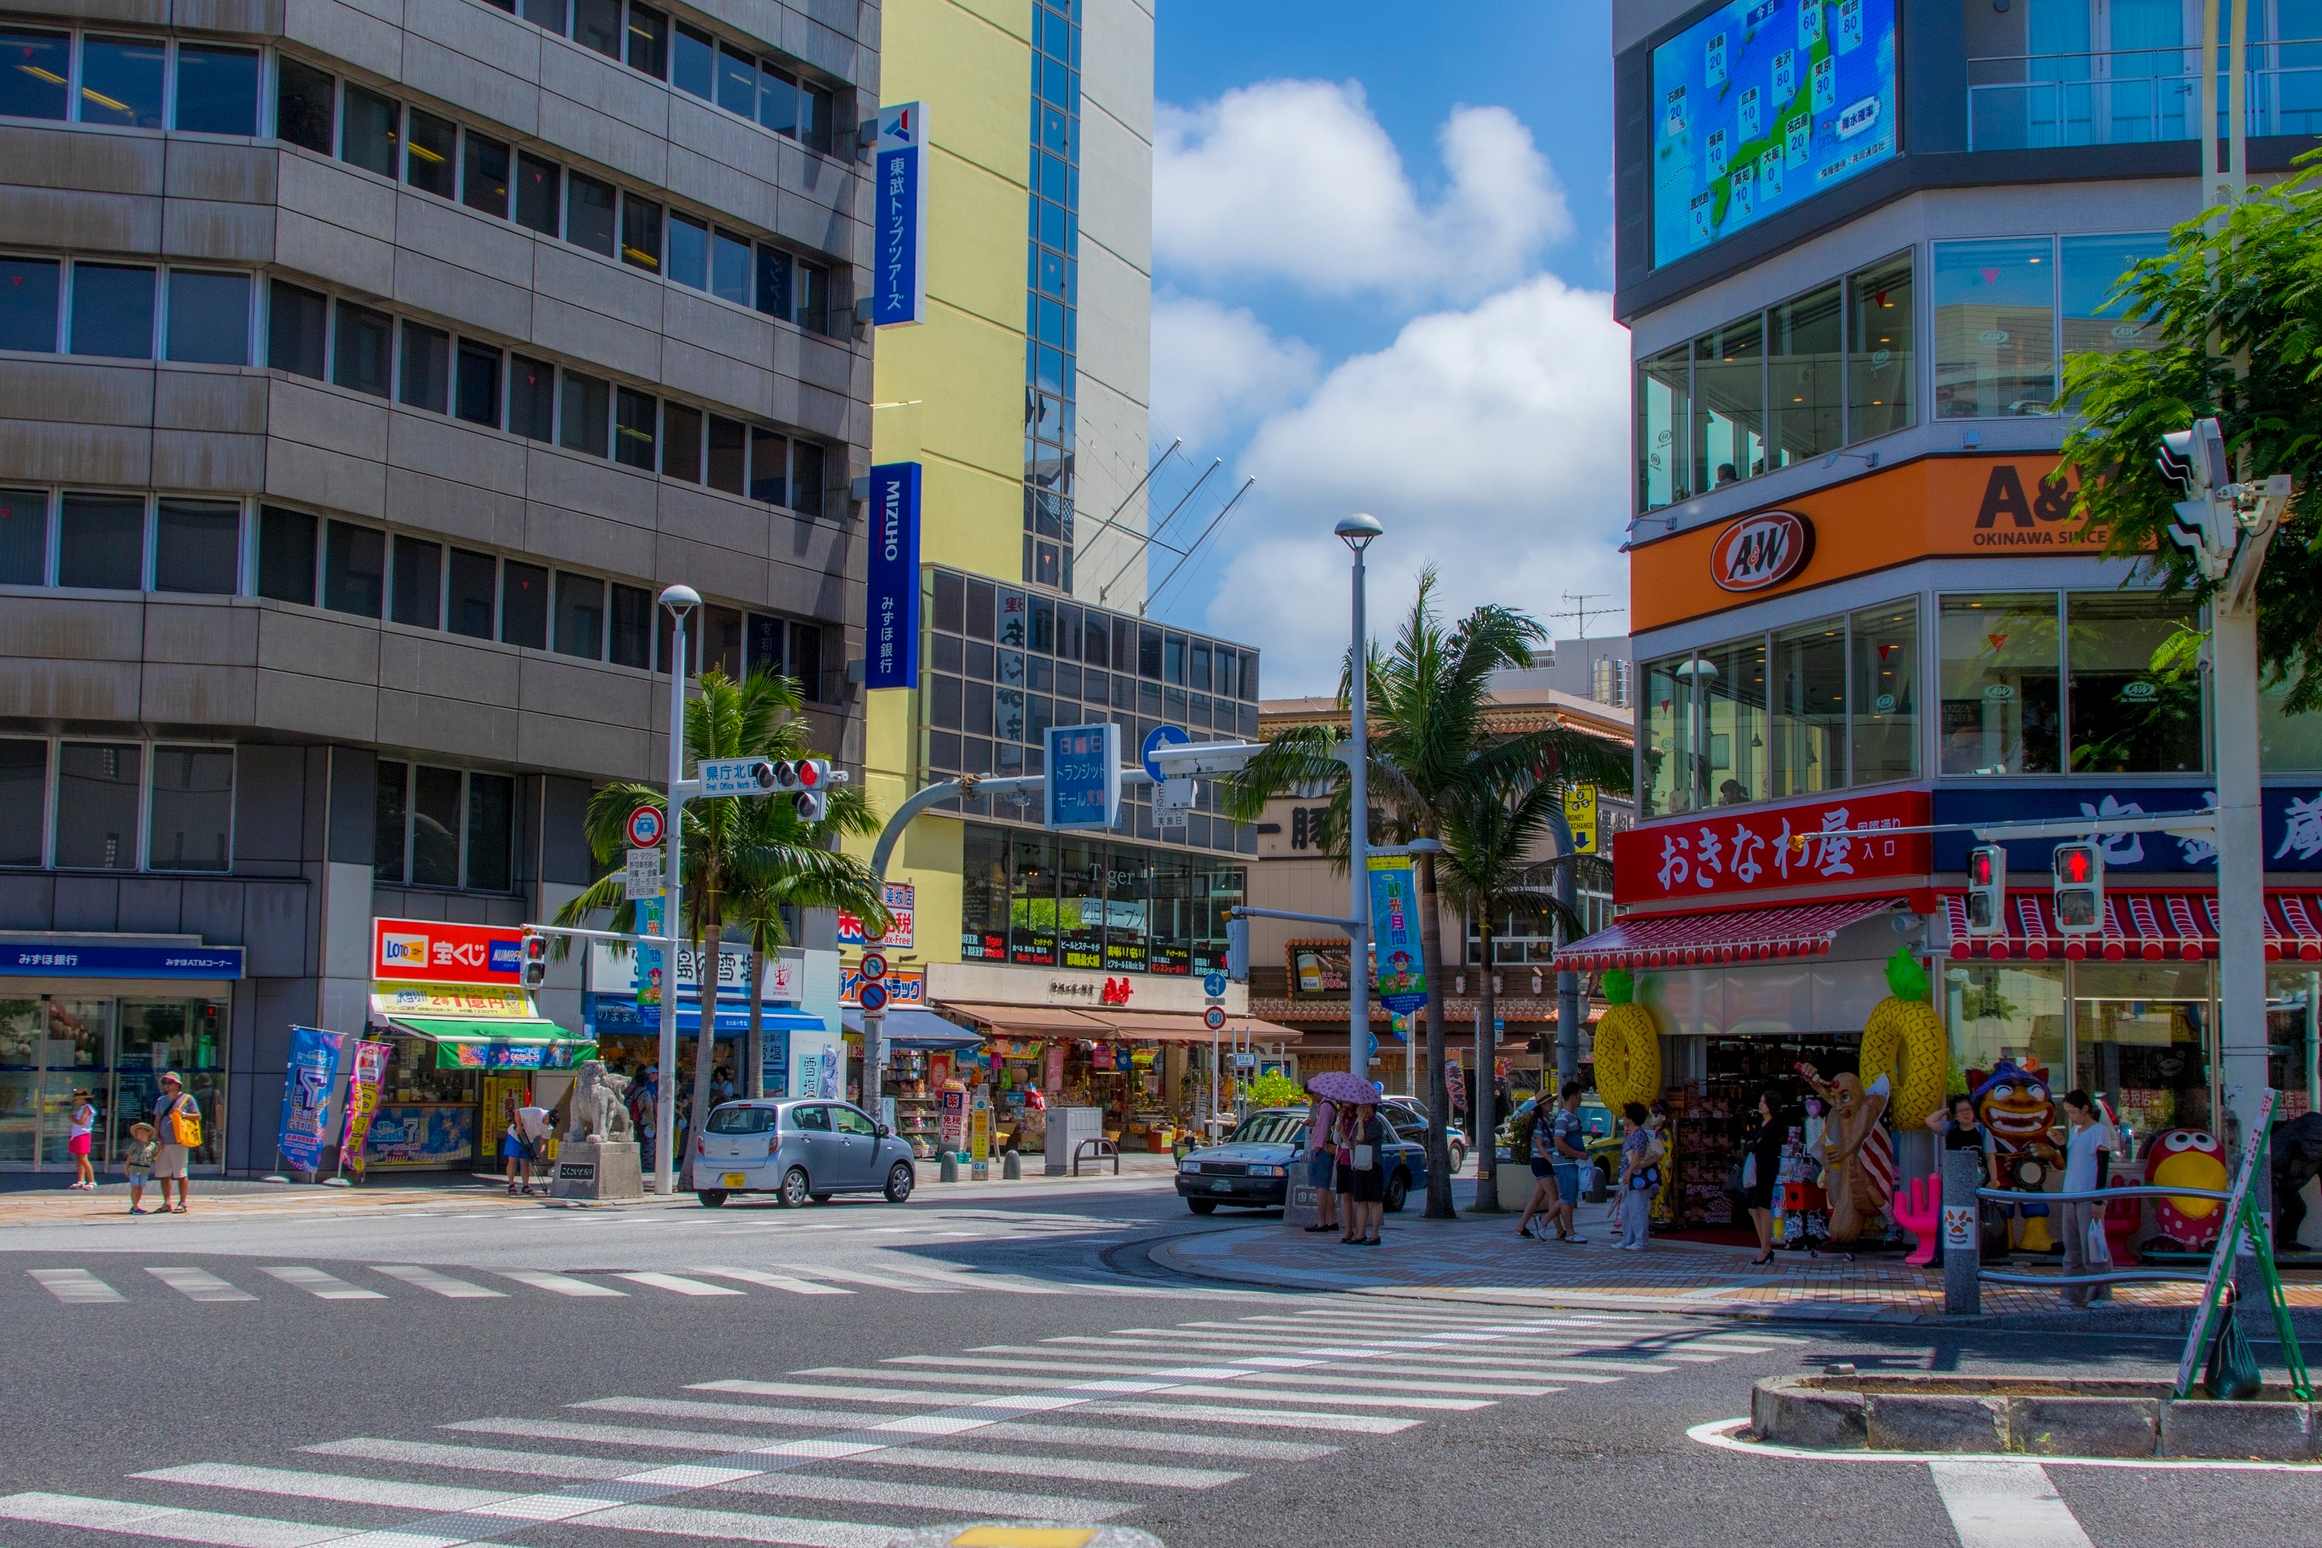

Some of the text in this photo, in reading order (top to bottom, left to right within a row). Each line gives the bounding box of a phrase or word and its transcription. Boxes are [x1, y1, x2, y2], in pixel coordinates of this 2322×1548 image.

[1803, 13, 1816, 30] 60
[1844, 16, 1857, 33] 80
[1710, 53, 1722, 70] 20
[1775, 51, 1791, 70] 金沢
[1815, 58, 1832, 78] 東京
[1777, 70, 1790, 87] 80
[1816, 77, 1830, 94] 30
[1741, 87, 1757, 106] 広島
[1670, 105, 1682, 121] 20
[1743, 106, 1755, 122] 10
[1841, 105, 1874, 132] 降水確率
[1787, 114, 1808, 135] 名古屋
[1708, 130, 1724, 148] 福岡
[1791, 134, 1804, 151] 20
[1710, 148, 1722, 164] 10
[1763, 147, 1779, 165] 大阪
[1734, 168, 1750, 187] 高知
[1768, 167, 1775, 182] 0
[1690, 190, 1709, 210] 鹿児島
[1735, 186, 1748, 203] 10
[1696, 210, 1703, 226] 0
[887, 157, 905, 311] 東武トップツアーズ
[884, 480, 900, 562] MIZUHO
[1973, 532, 2054, 546] OKINAWA
[2058, 530, 2107, 545] SINCE
[1725, 521, 1792, 583] A&W
[880, 596, 894, 674] みずほ銀行
[1942, 705, 1971, 713] OZZA
[1942, 714, 1974, 723] URGER
[1059, 735, 1103, 756] 日曜日
[706, 764, 757, 781] 県庁北口
[1056, 763, 1104, 781] トランジット
[720, 782, 735, 791] Office
[737, 781, 750, 789] North
[1057, 789, 1104, 807] モール実施
[1157, 817, 1182, 826] 実施日
[1570, 822, 1594, 830] XCHANGE
[1656, 806, 1854, 891] おきなわ屋
[1862, 840, 1895, 860] 入口
[629, 861, 658, 870] 許可車を除く
[1083, 901, 1145, 928] 21日 オープン
[884, 934, 911, 946] ax-Free
[962, 934, 1003, 948] BEER Tiger
[1033, 938, 1054, 947] ミッドナイト
[1061, 940, 1101, 952] ビールとステーキが
[386, 940, 409, 958] LOTO
[432, 941, 485, 967] 宝くじ
[967, 946, 985, 957] BEEF
[985, 947, 1005, 958] Steak
[1016, 953, 1031, 962] Music
[1165, 949, 1188, 958] ディナータイム
[19, 954, 78, 966] みずほ銀行
[165, 958, 233, 967] みずほATMコーナー
[1208, 1012, 1222, 1024] 30
[561, 1166, 593, 1177] こくさいどおり
[974, 1162, 985, 1171] 0.4
